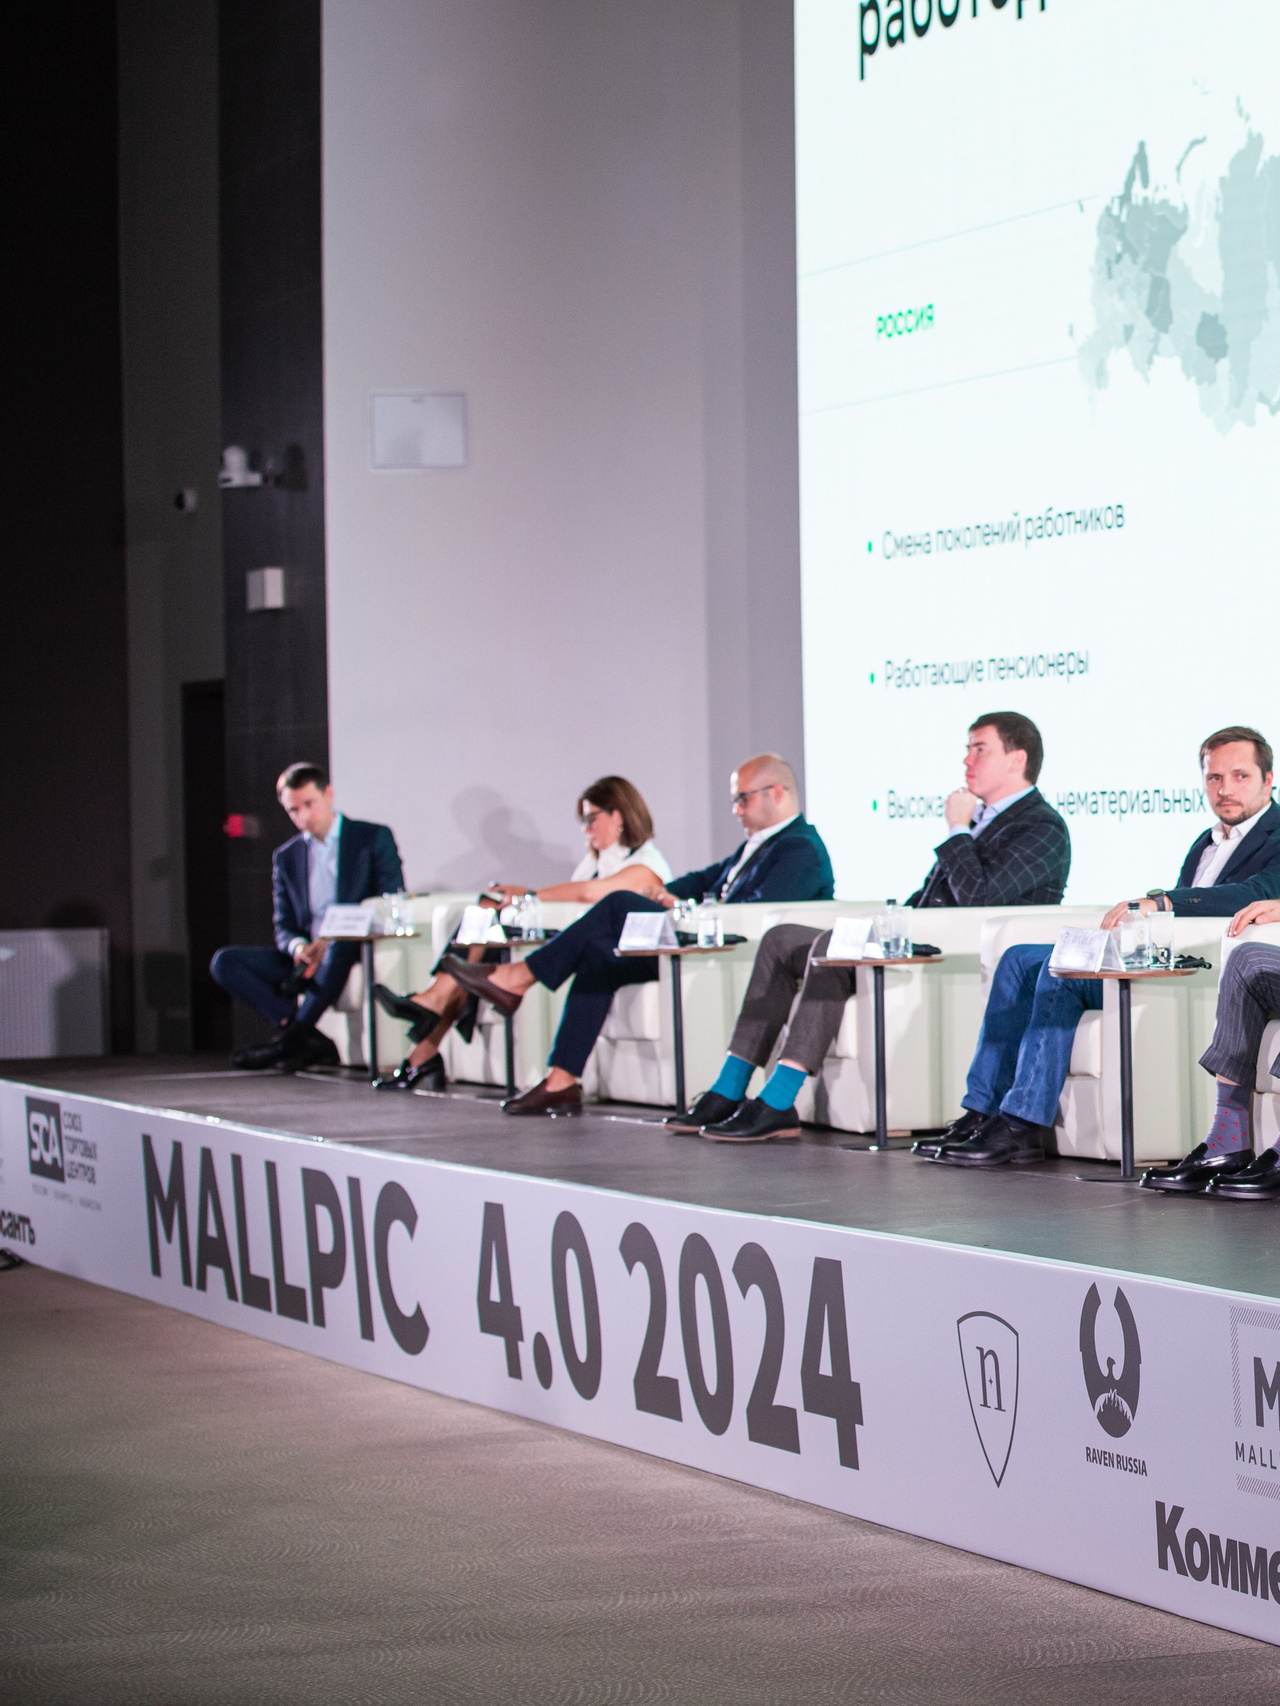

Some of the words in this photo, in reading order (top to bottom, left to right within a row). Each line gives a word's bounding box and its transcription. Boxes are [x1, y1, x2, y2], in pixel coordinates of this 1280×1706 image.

[876, 303, 935, 341] РОССИЯ
[882, 530, 932, 560] Смена
[936, 511, 1021, 553] поколений
[1025, 503, 1126, 548] работников
[885, 659, 984, 690] Работающие
[989, 649, 1090, 683] пенсионеры
[887, 789, 944, 819] Высока
[1057, 786, 1206, 822] нематериальных
[29, 1111, 63, 1169] SCA
[141, 1133, 430, 1356] MALLPIC
[476, 1201, 602, 1401] 4.0
[618, 1221, 864, 1471] 2024
[1085, 1446, 1116, 1468] RAVEN
[1117, 1456, 1148, 1477] RUSSIA
